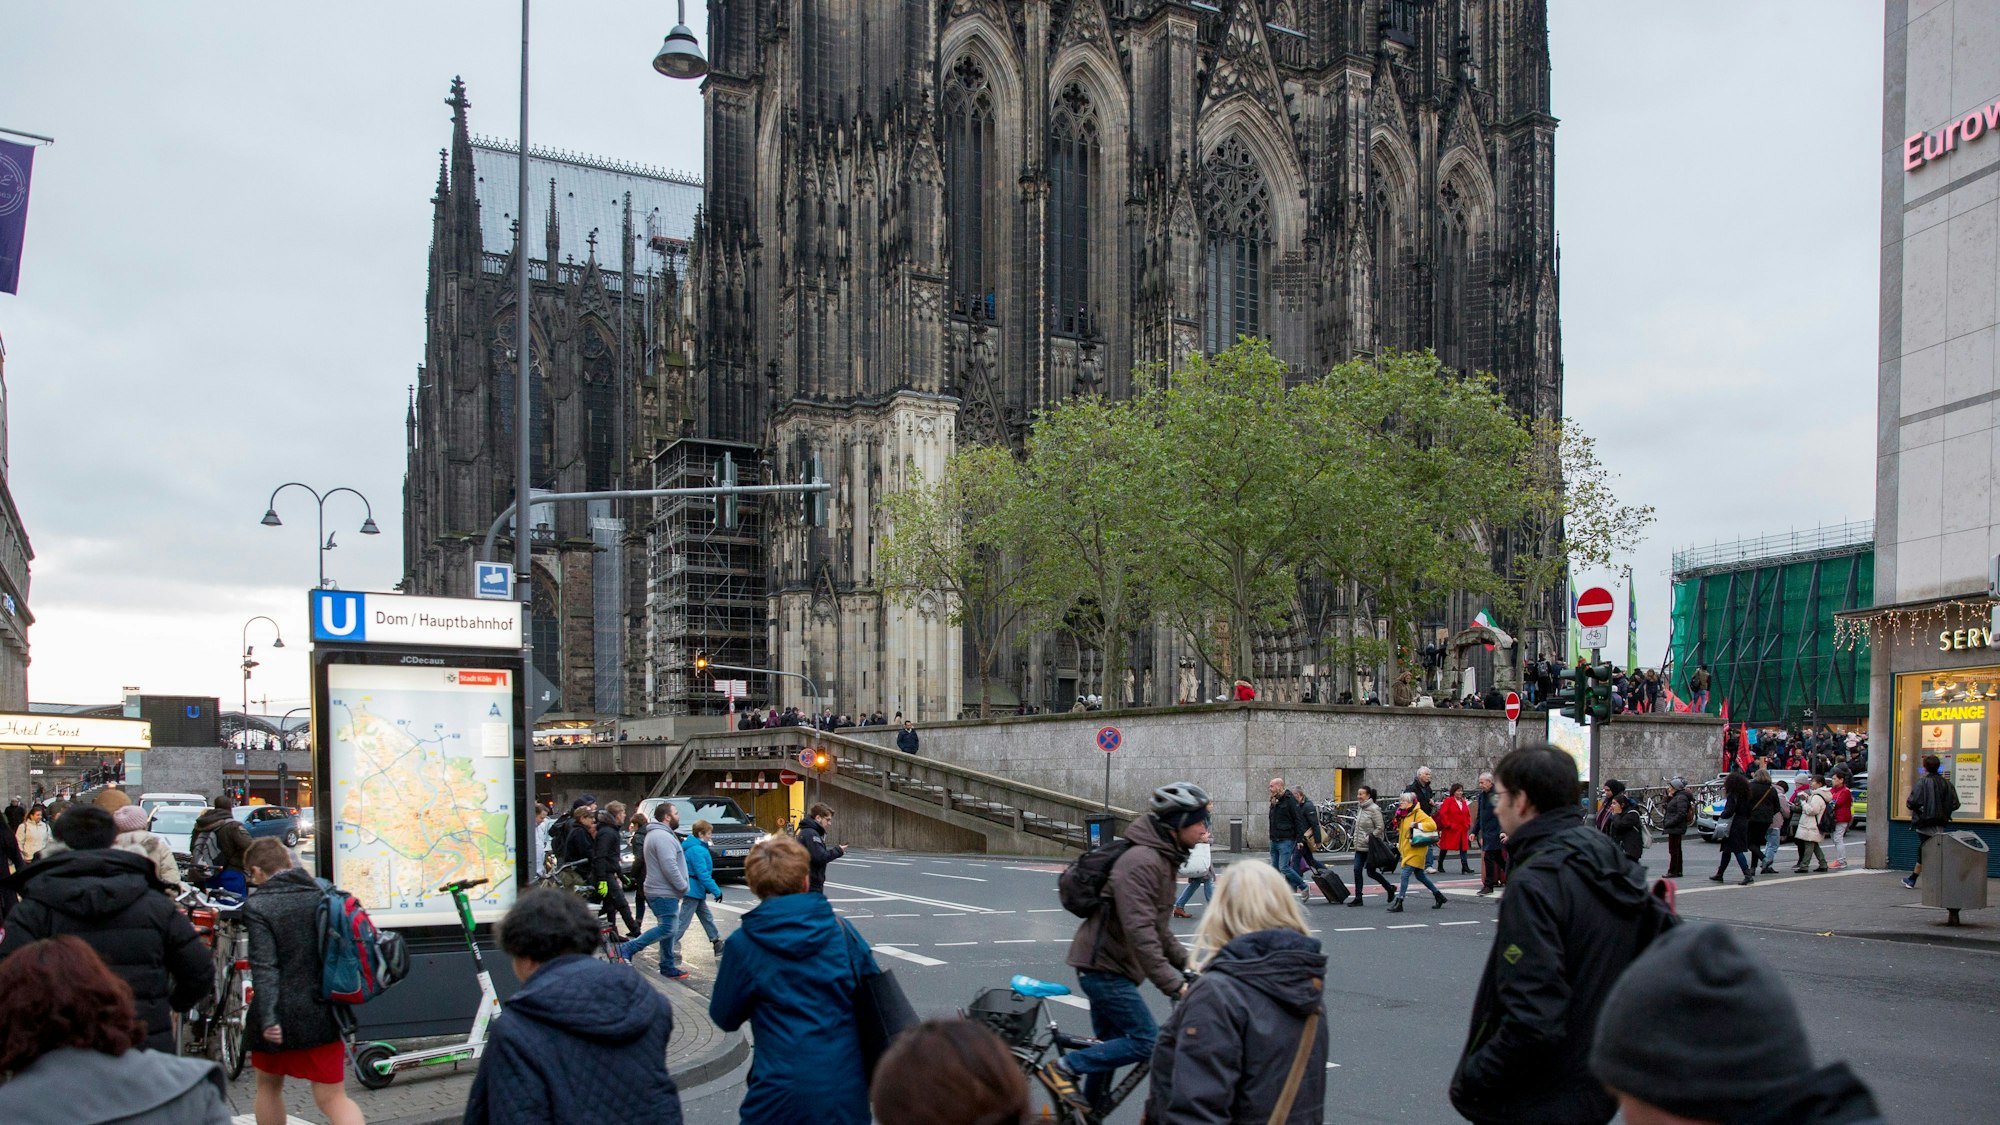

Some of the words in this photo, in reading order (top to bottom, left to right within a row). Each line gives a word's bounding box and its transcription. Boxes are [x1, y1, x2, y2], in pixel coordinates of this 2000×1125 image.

[321, 596, 356, 636] U
[376, 611, 408, 625] Dom
[419, 613, 513, 630] Hauptbahnhof
[400, 655, 445, 665] JCDecaux
[459, 674, 477, 683] Stadt
[187, 705, 200, 718] U
[1920, 705, 1985, 721] EXCHANGE
[0, 721, 41, 736] Hotel
[47, 722, 80, 737] Ernst
